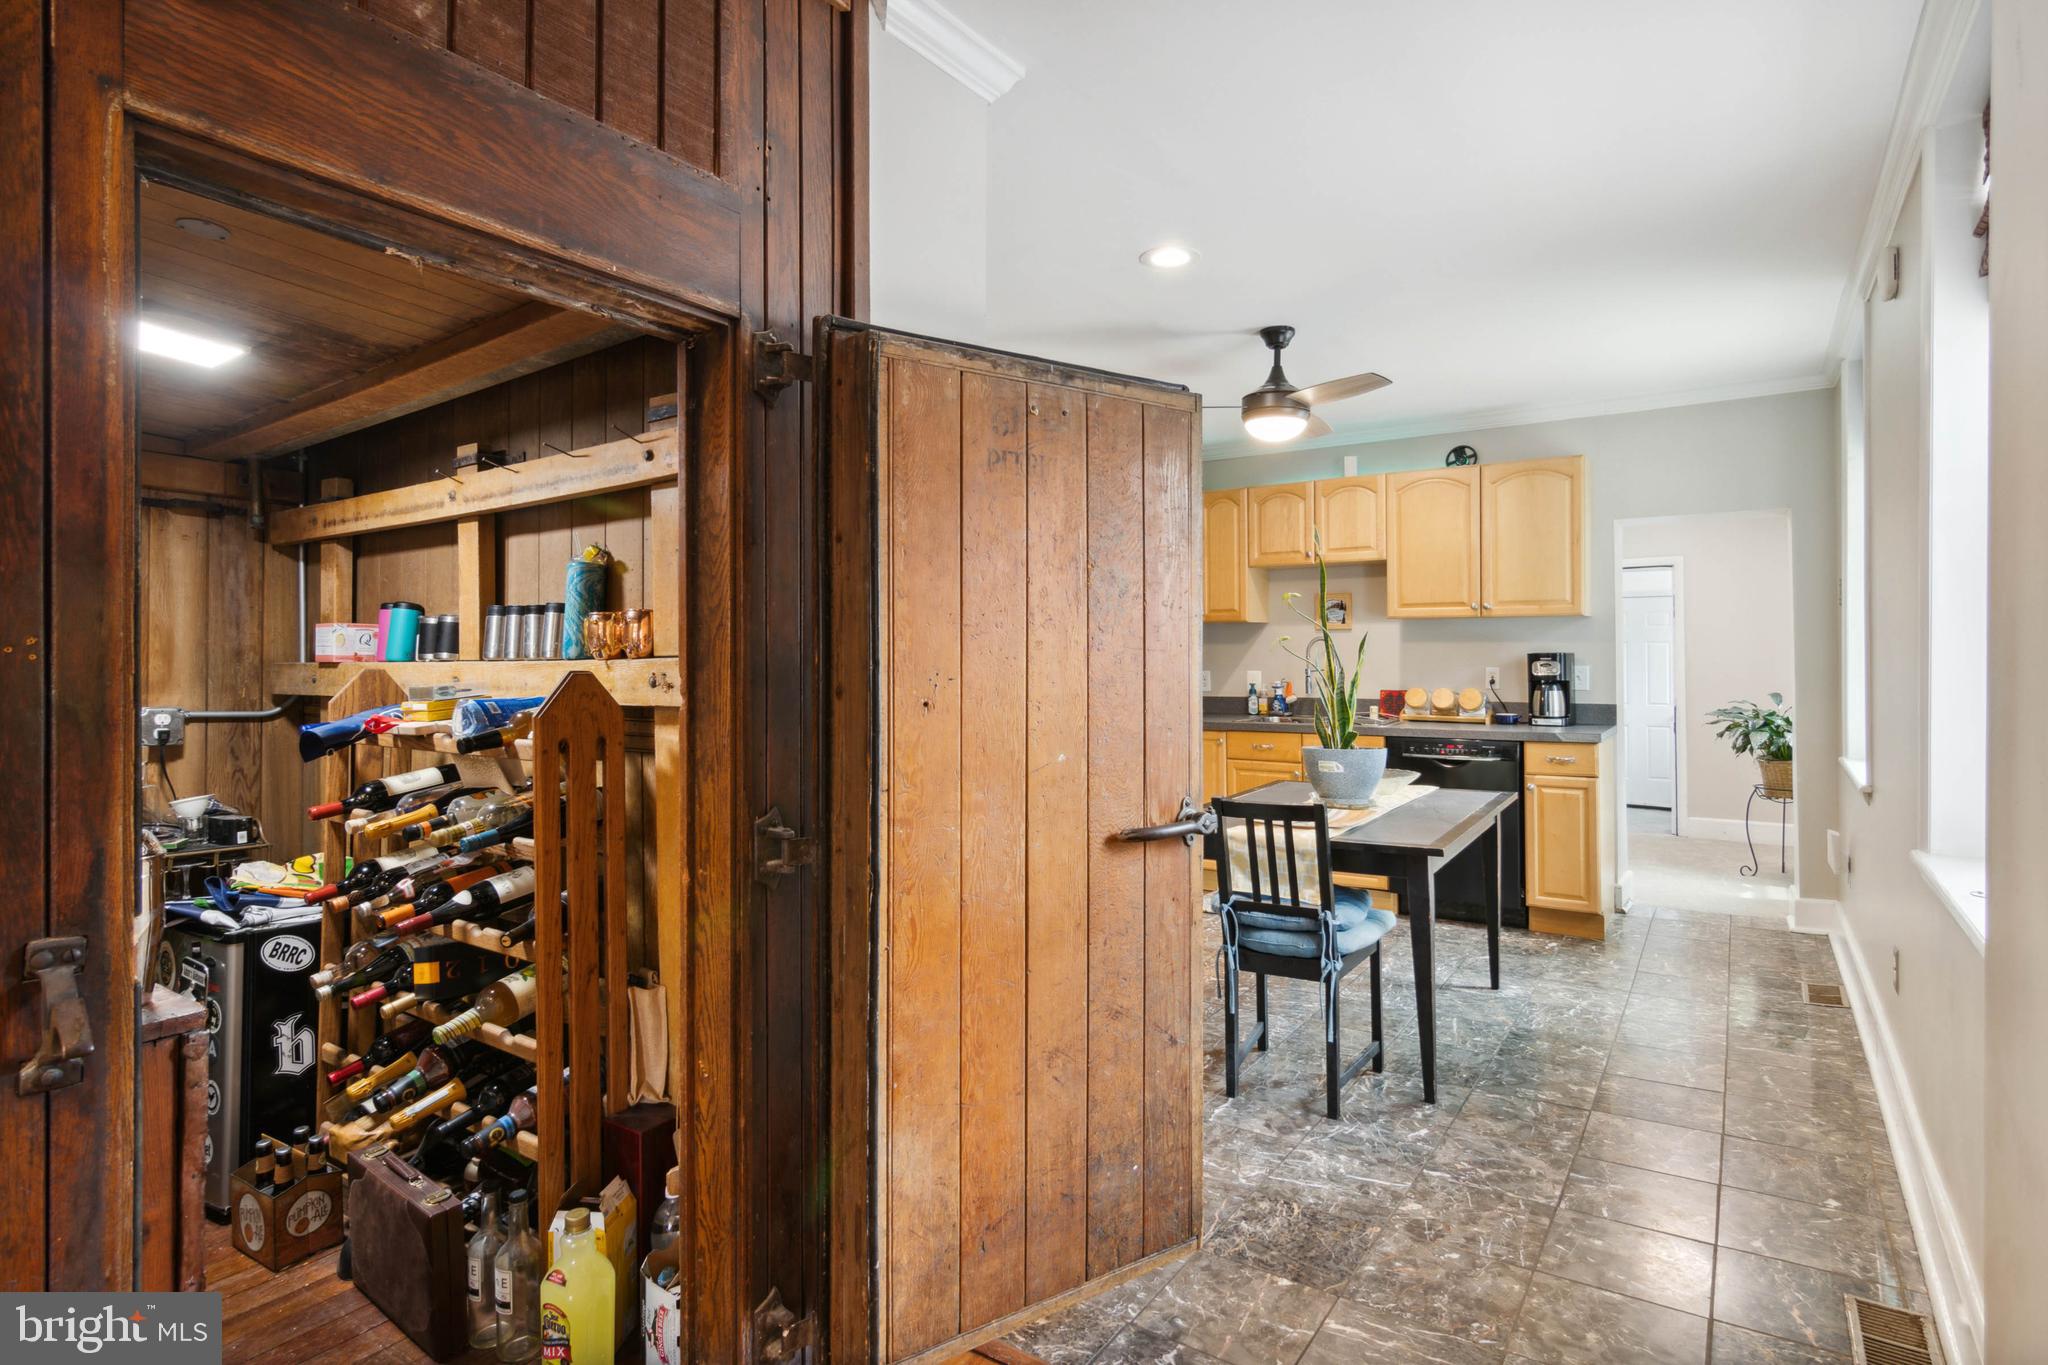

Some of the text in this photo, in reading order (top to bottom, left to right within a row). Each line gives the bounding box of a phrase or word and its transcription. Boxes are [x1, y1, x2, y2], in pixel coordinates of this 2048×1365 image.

[268, 941, 307, 966] BRRC
[287, 1194, 326, 1228] PUMPKIN
[310, 1203, 329, 1223] ALE
[543, 1346, 565, 1357] MIX
